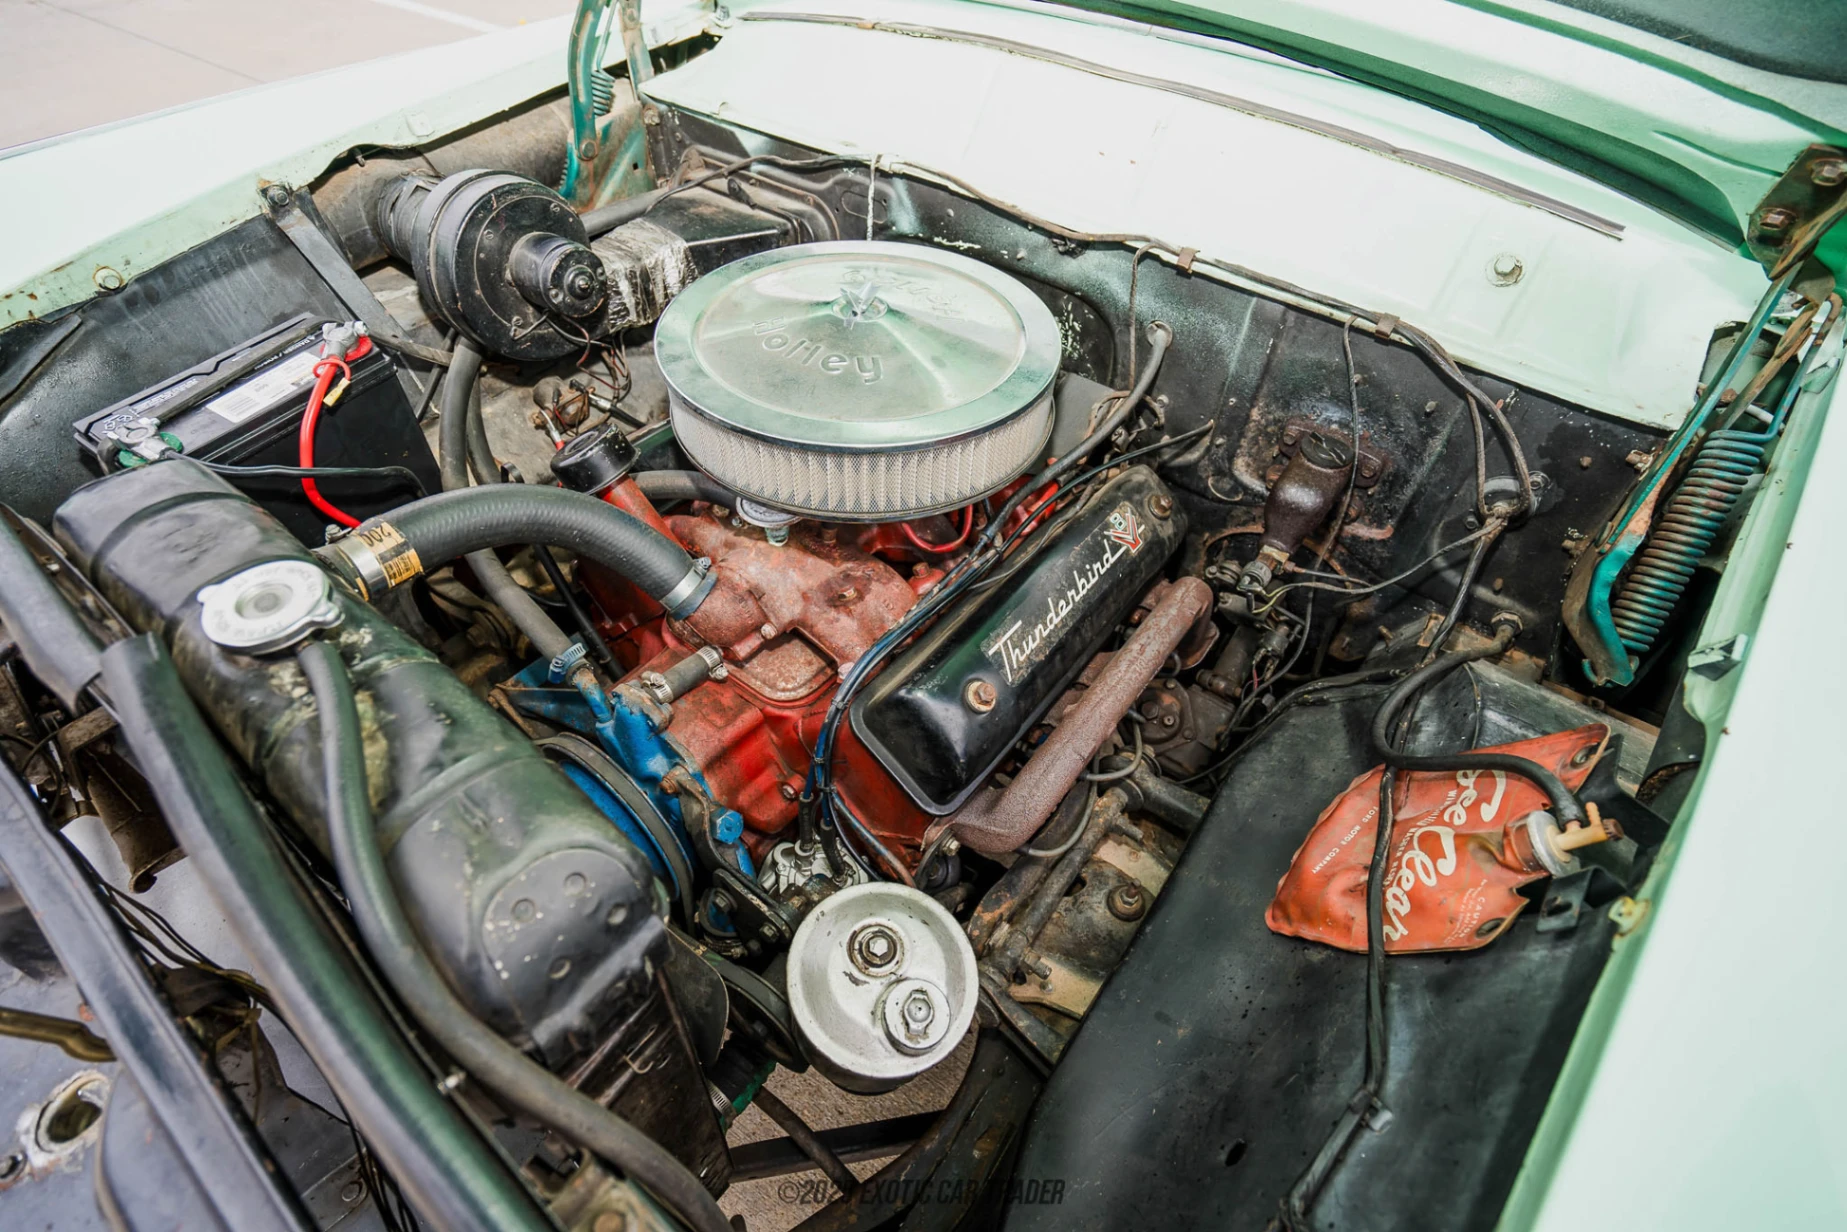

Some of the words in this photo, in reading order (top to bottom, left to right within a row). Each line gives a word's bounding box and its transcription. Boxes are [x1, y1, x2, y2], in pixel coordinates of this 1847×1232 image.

[752, 316, 884, 385] Holley
[988, 539, 1128, 683] Thunderbird
[1311, 847, 1340, 875] COMPANY
[1340, 824, 1361, 846] MOTOR
[1384, 825, 1457, 943] Clear
[1459, 896, 1486, 938] CAUTION
